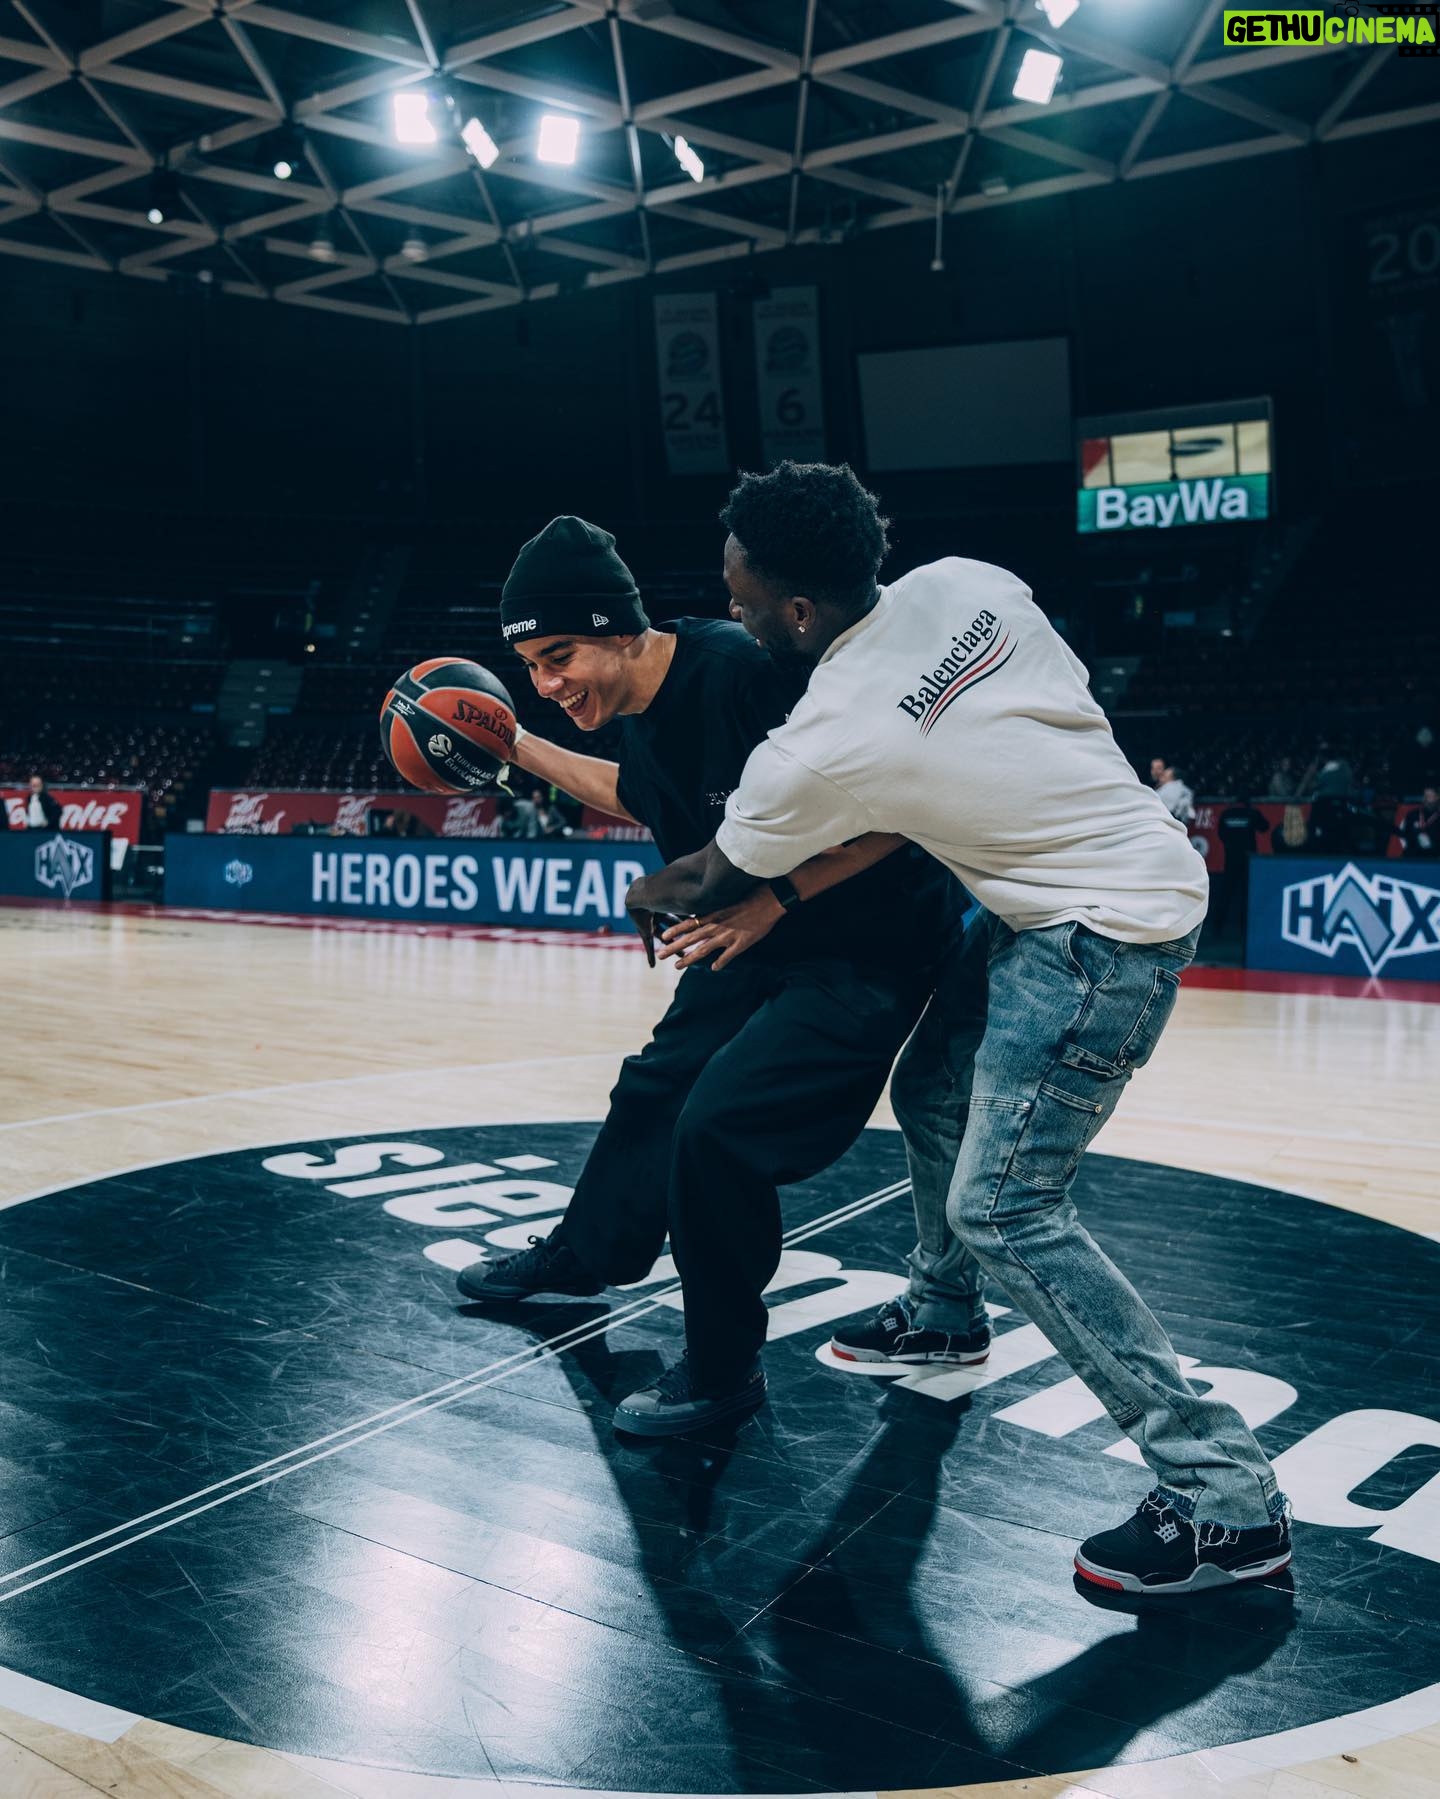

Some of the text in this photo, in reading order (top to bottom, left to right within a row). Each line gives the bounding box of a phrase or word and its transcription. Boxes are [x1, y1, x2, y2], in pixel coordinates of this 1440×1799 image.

[663, 393, 724, 430] 24
[777, 387, 806, 427] 6
[1096, 478, 1250, 530] BayWa
[897, 609, 998, 723] Balenciaga
[452, 699, 515, 751] SPALDIN
[311, 850, 479, 913] HEROES
